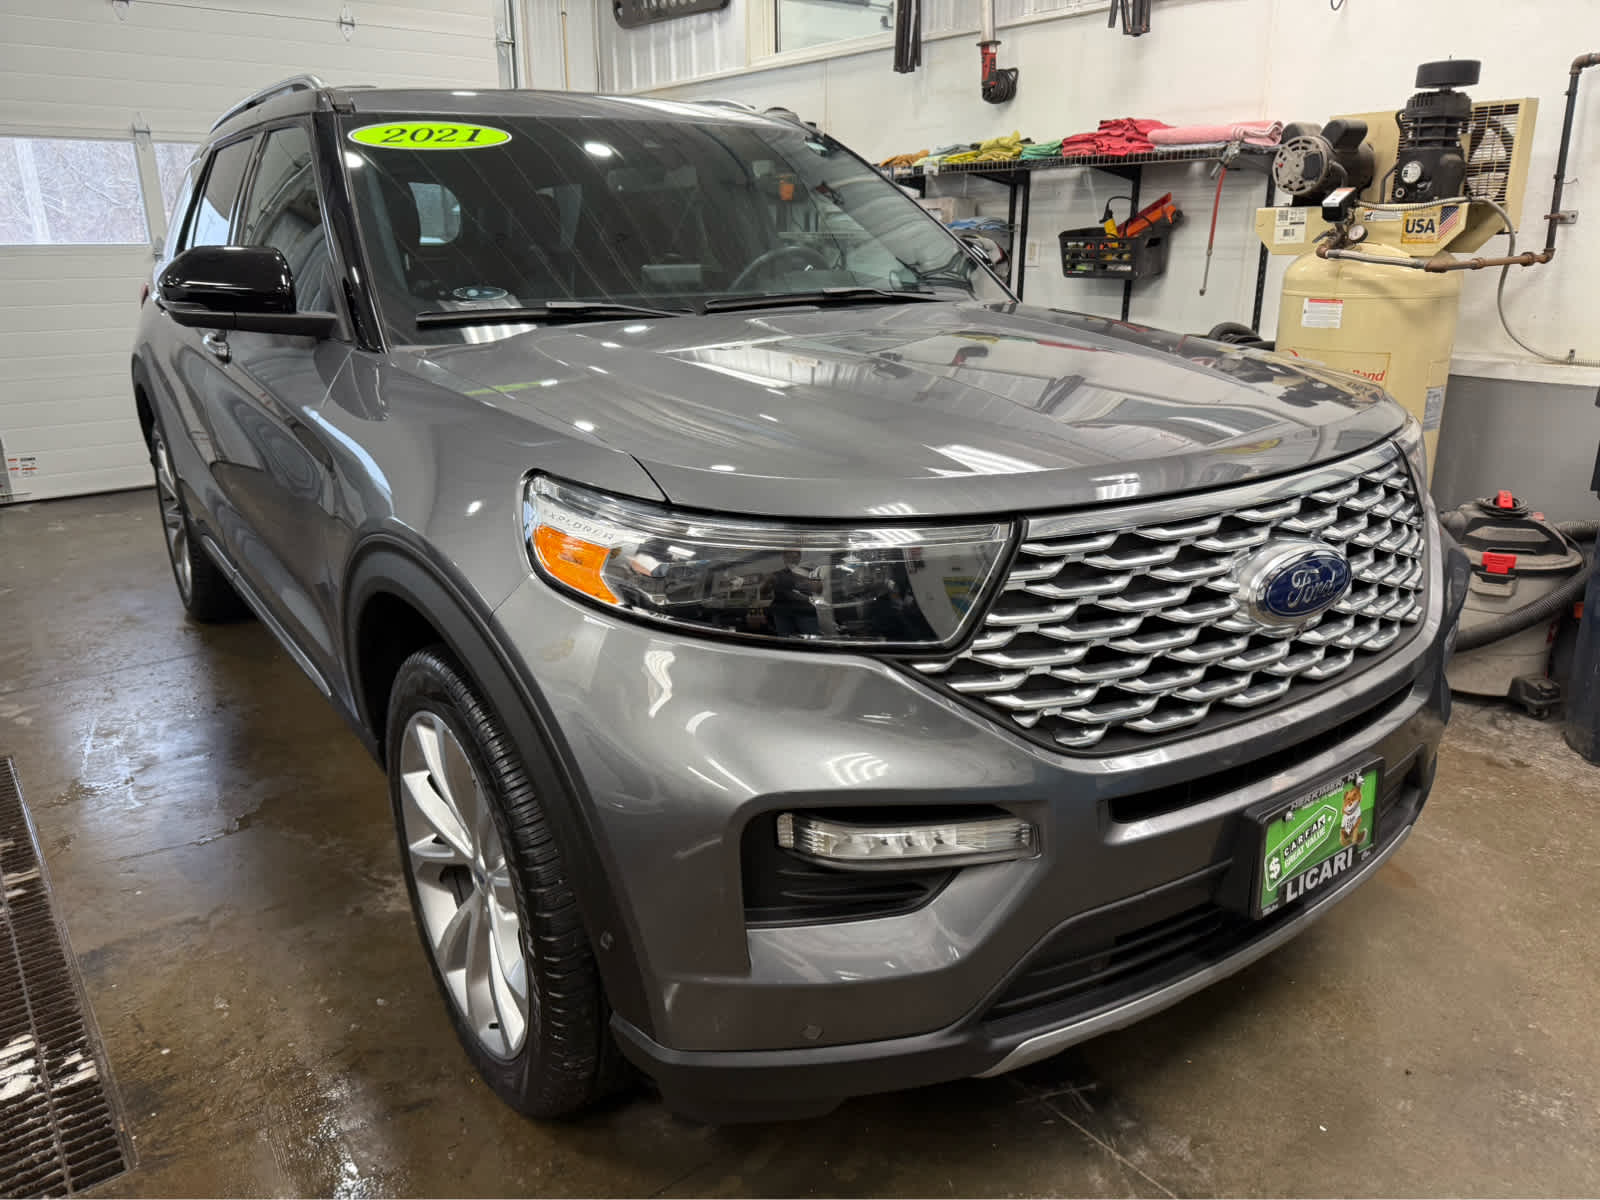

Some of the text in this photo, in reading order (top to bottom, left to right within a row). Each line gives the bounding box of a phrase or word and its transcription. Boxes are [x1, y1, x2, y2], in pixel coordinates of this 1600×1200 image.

[381, 127, 482, 143] 2021
[1405, 218, 1435, 234] USA
[1287, 567, 1336, 608] Ford
[1286, 847, 1354, 903] LICARI
